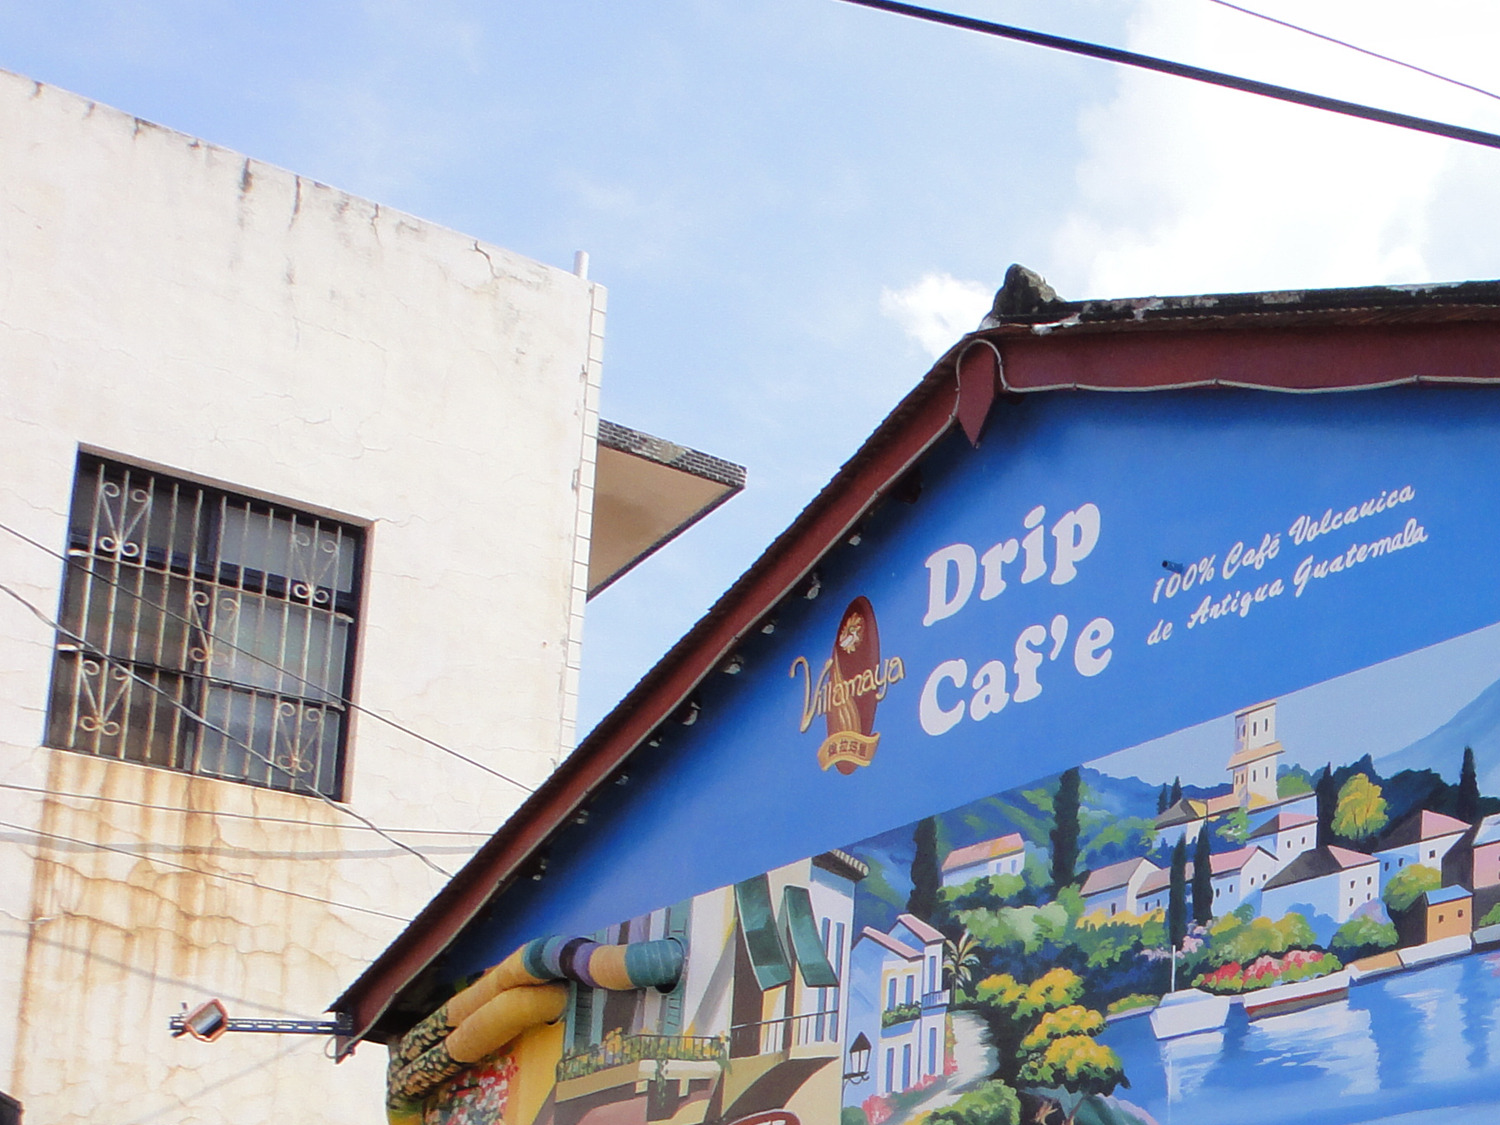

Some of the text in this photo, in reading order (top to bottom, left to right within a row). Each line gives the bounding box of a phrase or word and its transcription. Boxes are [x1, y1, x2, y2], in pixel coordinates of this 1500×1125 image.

[923, 502, 1101, 627] Drip
[1147, 619, 1173, 645] de
[1293, 518, 1429, 598] Guatemala
[1152, 554, 1217, 603] 100%
[1221, 532, 1282, 580] Café
[789, 656, 906, 733] Villamaya
